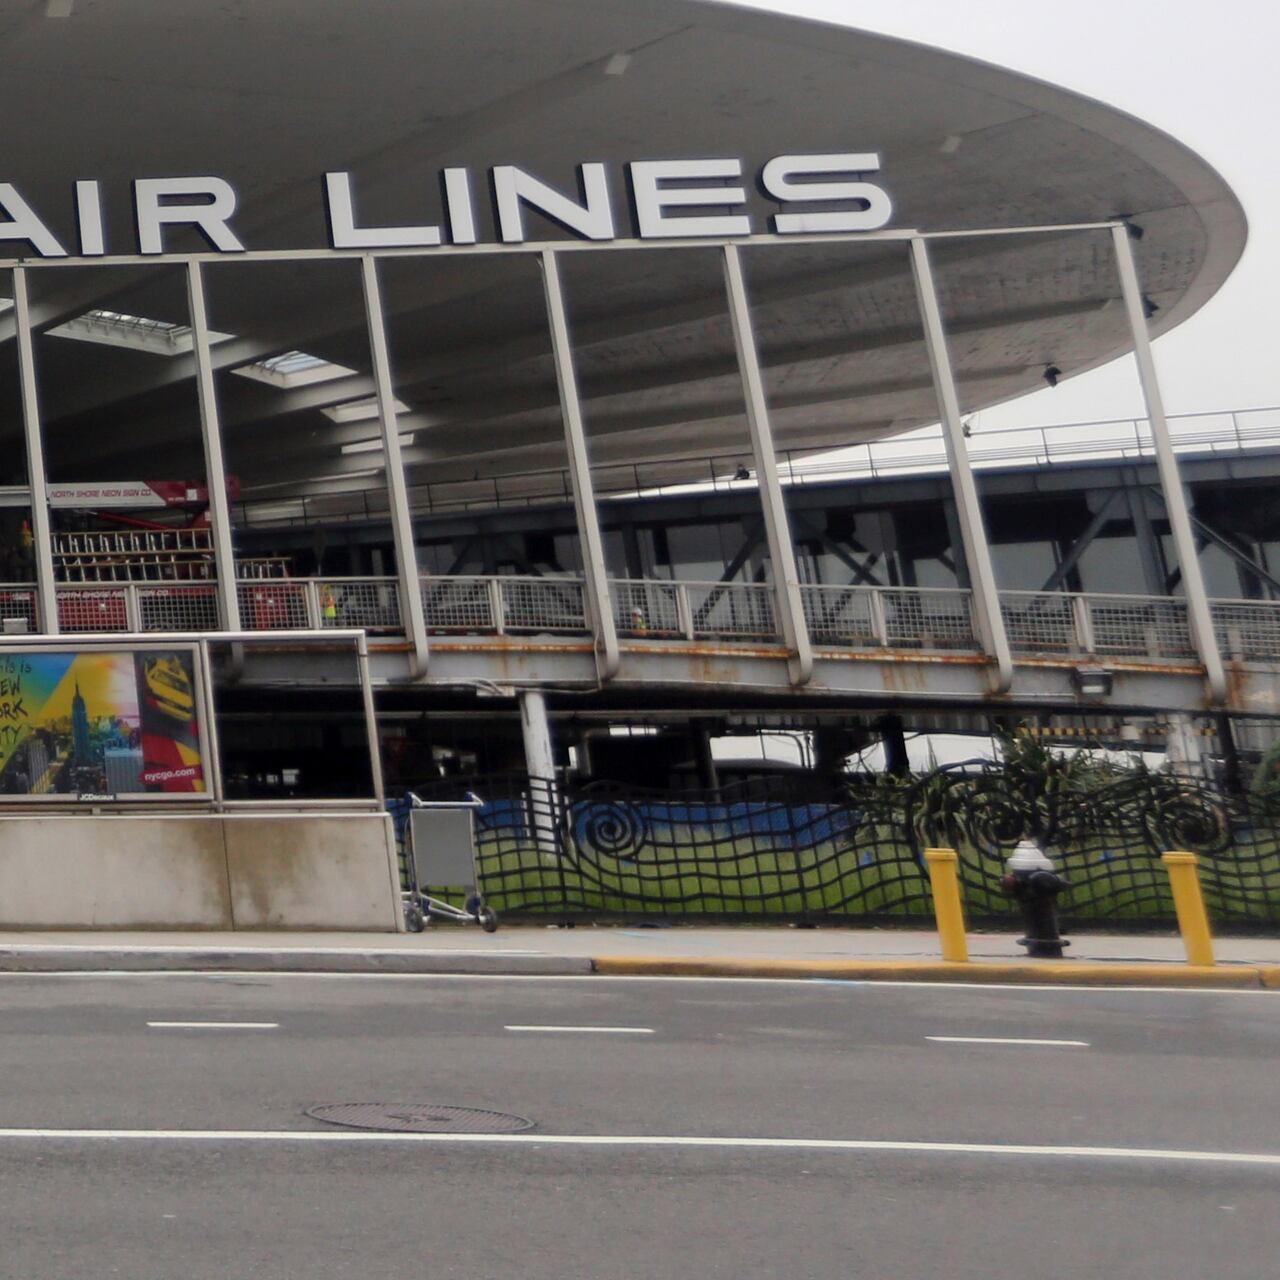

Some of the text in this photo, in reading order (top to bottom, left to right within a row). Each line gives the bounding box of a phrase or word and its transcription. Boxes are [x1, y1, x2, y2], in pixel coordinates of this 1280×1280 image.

[325, 152, 894, 251] LINES
[50, 490, 74, 498] NORTH
[76, 490, 99, 498] SHORE
[101, 489, 122, 497] NEON
[123, 489, 139, 497] SIGN
[20, 660, 32, 674] is
[144, 768, 195, 782] nycgo.com
